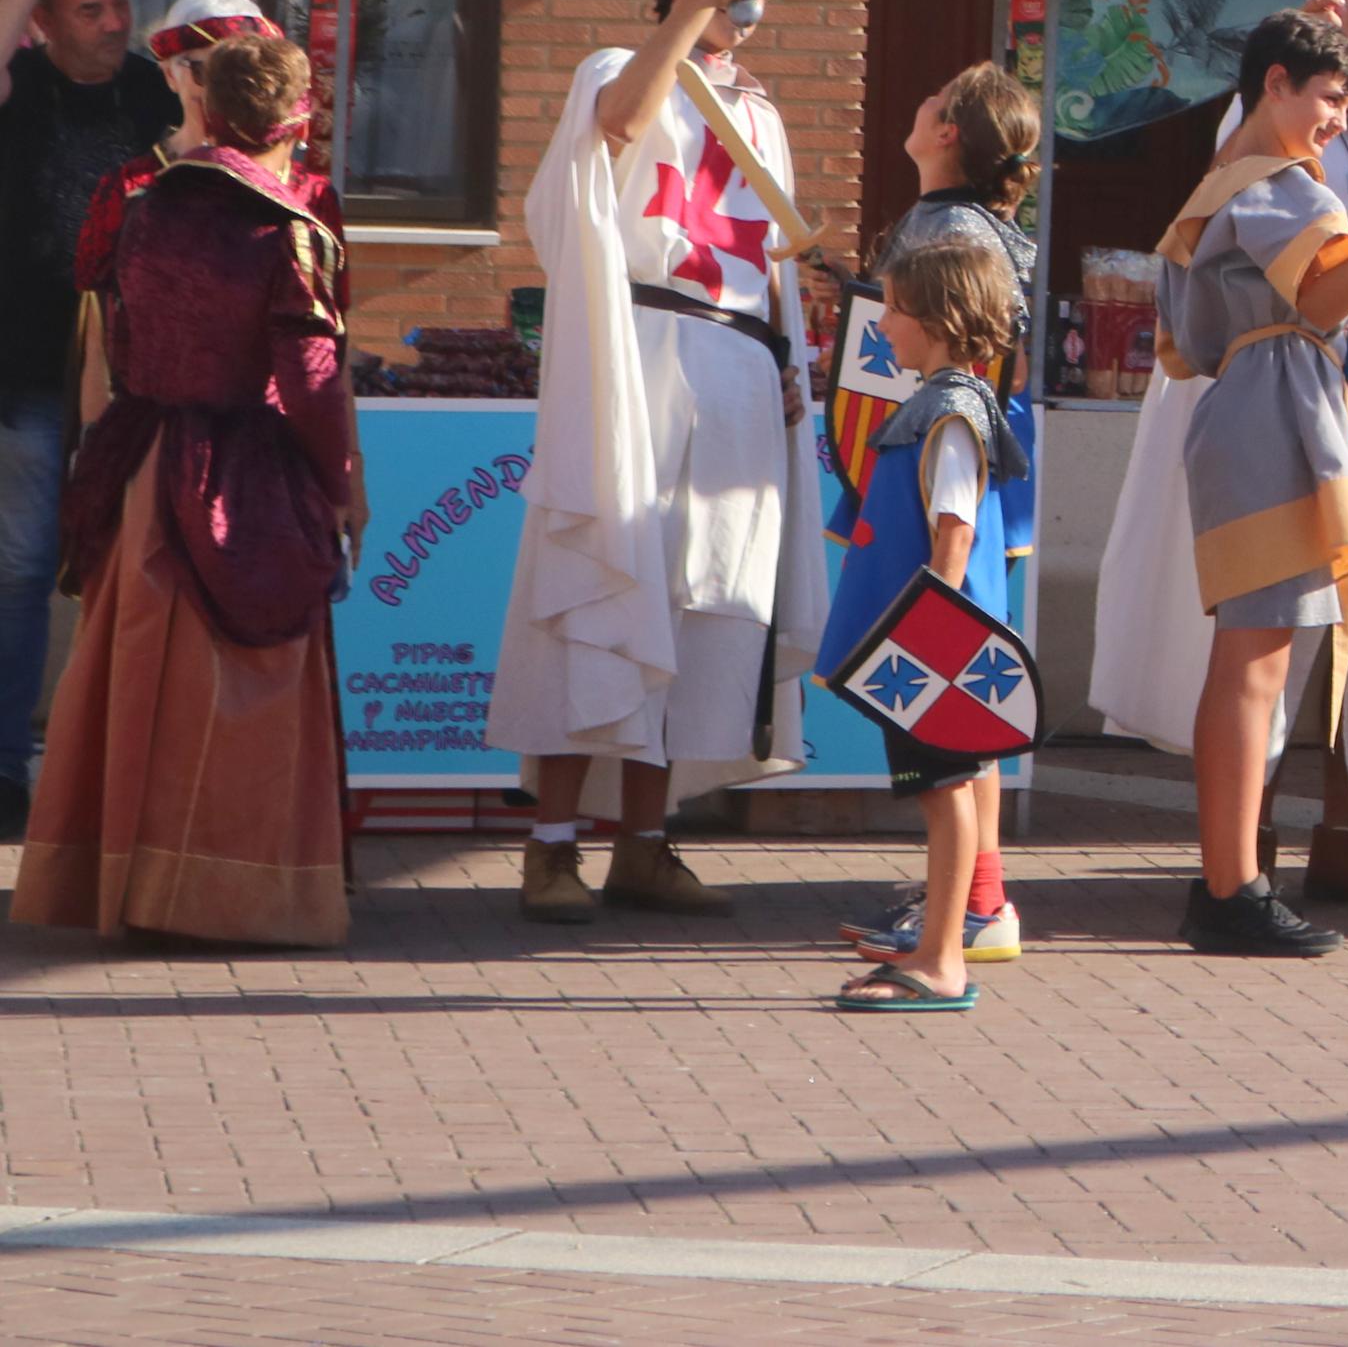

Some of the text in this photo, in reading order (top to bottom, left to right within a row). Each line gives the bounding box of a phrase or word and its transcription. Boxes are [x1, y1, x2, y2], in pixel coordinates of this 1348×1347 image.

[369, 445, 536, 606] ALMEND
[391, 642, 475, 665] PIPAS
[346, 671, 496, 697] CACAHUETE
